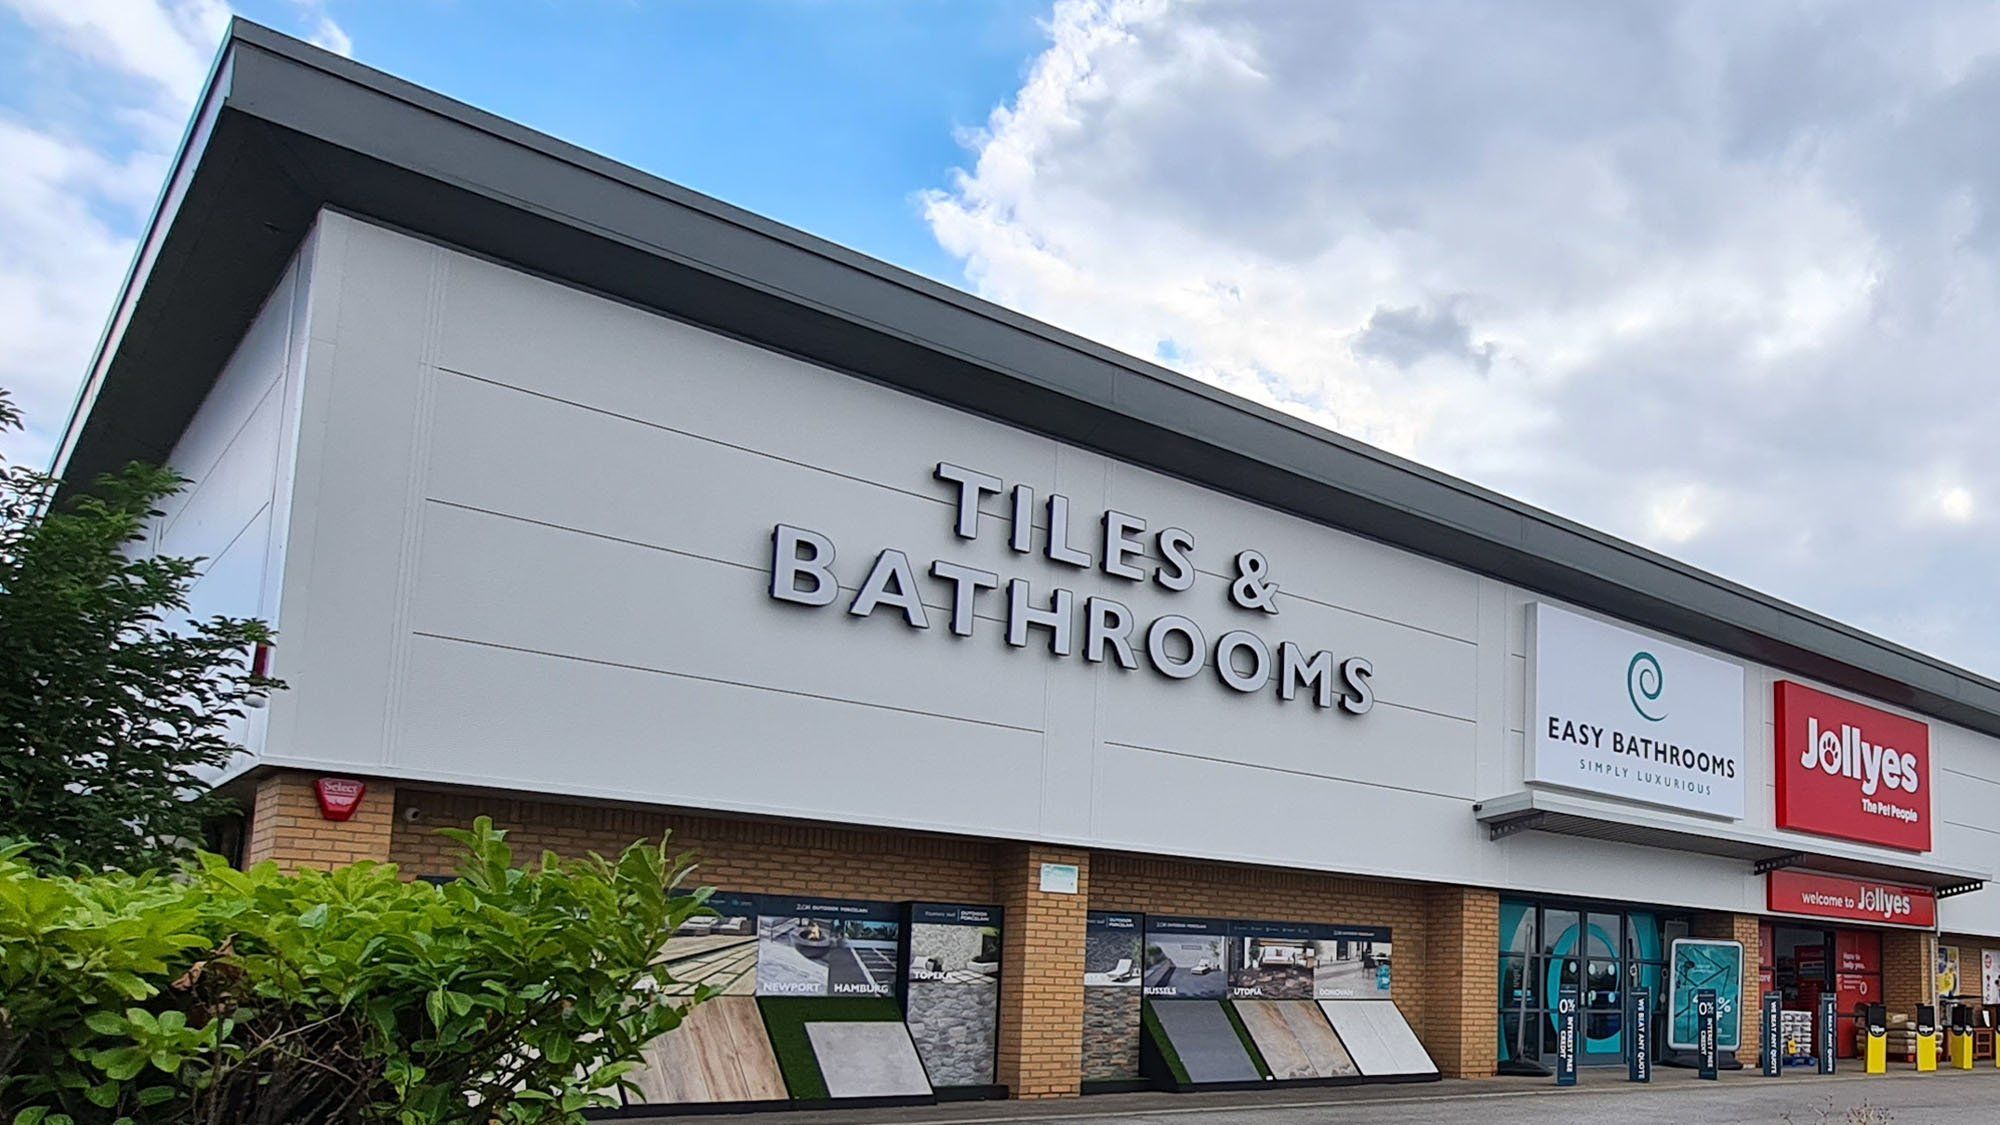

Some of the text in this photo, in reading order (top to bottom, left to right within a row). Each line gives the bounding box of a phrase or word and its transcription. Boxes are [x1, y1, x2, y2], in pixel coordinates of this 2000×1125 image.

[933, 462, 1280, 615] TILES &
[769, 523, 1374, 715] BATHROOMS
[1548, 716, 1735, 778] EASY BATHROOMS
[1801, 717, 1919, 795] Jollyes
[1579, 759, 1711, 795] SIMPLY LUXURIOUS
[324, 781, 358, 793] Select
[1862, 799, 1918, 823] The Pet People
[1801, 887, 1911, 918] welcome to Jollyes
[763, 982, 820, 993] NEWPORT
[833, 983, 889, 993] HAMBURG
[1233, 987, 1263, 996] UTOPIA
[1638, 998, 1645, 1011] WE
[1770, 1001, 1777, 1013] WE
[1827, 1002, 1832, 1014] WE
